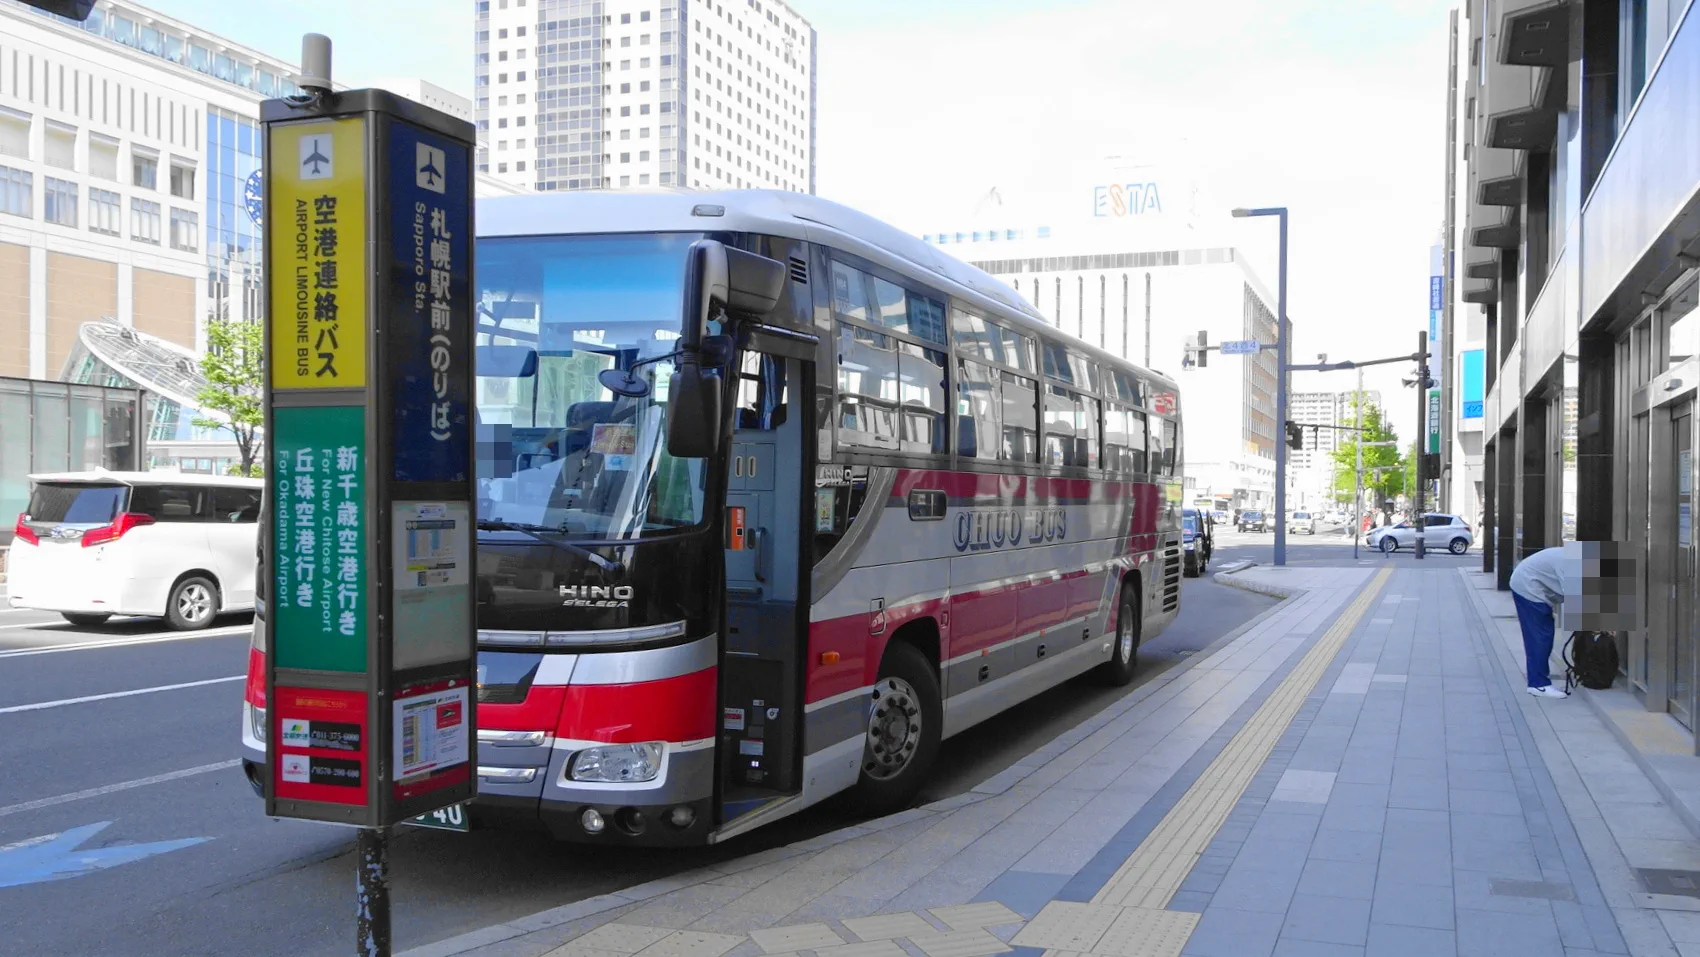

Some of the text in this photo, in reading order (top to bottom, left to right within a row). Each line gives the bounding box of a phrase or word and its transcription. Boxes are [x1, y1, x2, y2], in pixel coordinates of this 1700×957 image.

[413, 201, 427, 314] Sapporo Sta.
[1094, 182, 1162, 217] ESTA
[296, 199, 309, 377] AIRPORT LIMOUSINE BUS
[313, 195, 338, 378] 空港連絡バス
[279, 450, 291, 608] For Okadama Airport
[294, 447, 316, 608] 丘珠空港行き
[320, 448, 334, 633] For New Chitose Airport
[336, 445, 359, 637] 新千歳空港行き
[559, 585, 634, 600] HINO
[562, 599, 629, 608] SELEGA
[953, 507, 1067, 552] CHUO BUS
